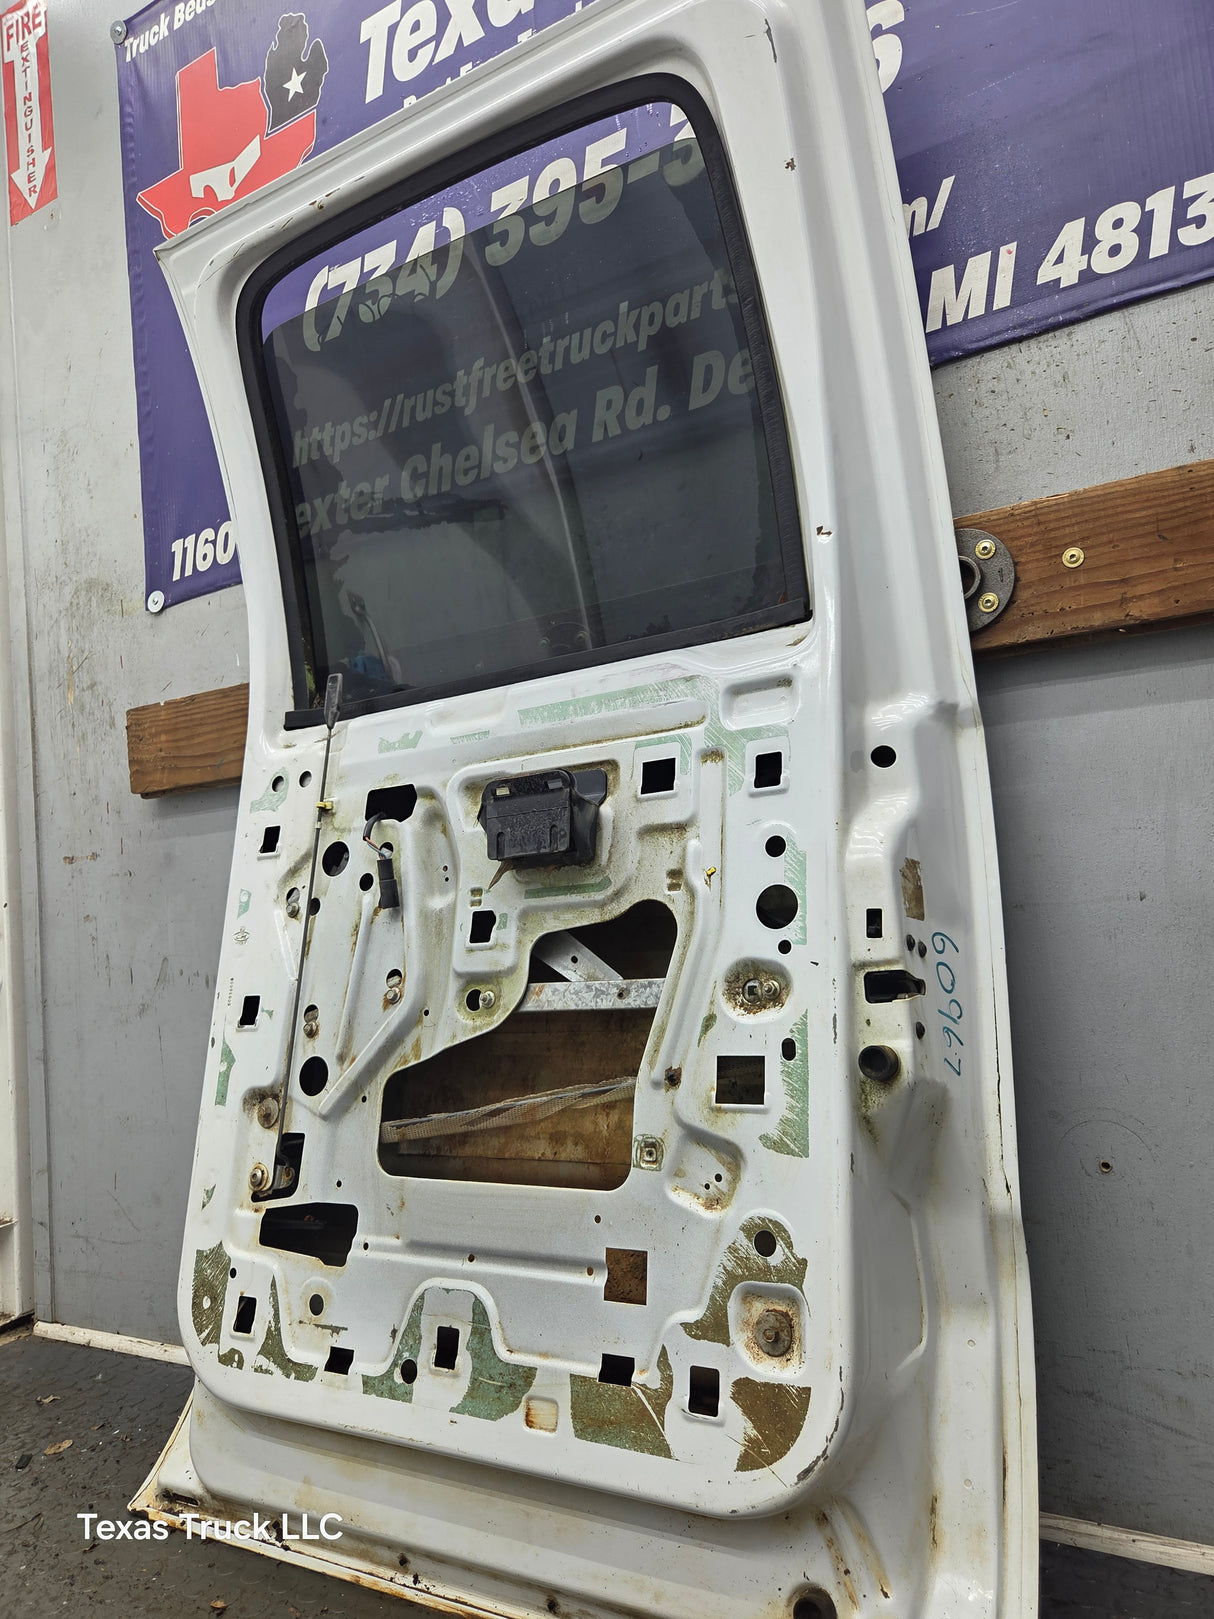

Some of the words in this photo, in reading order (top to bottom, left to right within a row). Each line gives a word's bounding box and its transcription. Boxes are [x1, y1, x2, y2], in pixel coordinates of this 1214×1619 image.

[6, 3, 43, 52] FIRE
[125, 13, 170, 62] Truck
[21, 40, 38, 198] EXTINGUISHER
[302, 206, 466, 352] (734)
[401, 408, 578, 503] Chelsea
[592, 364, 671, 443] Rd.
[925, 241, 1017, 334] MI
